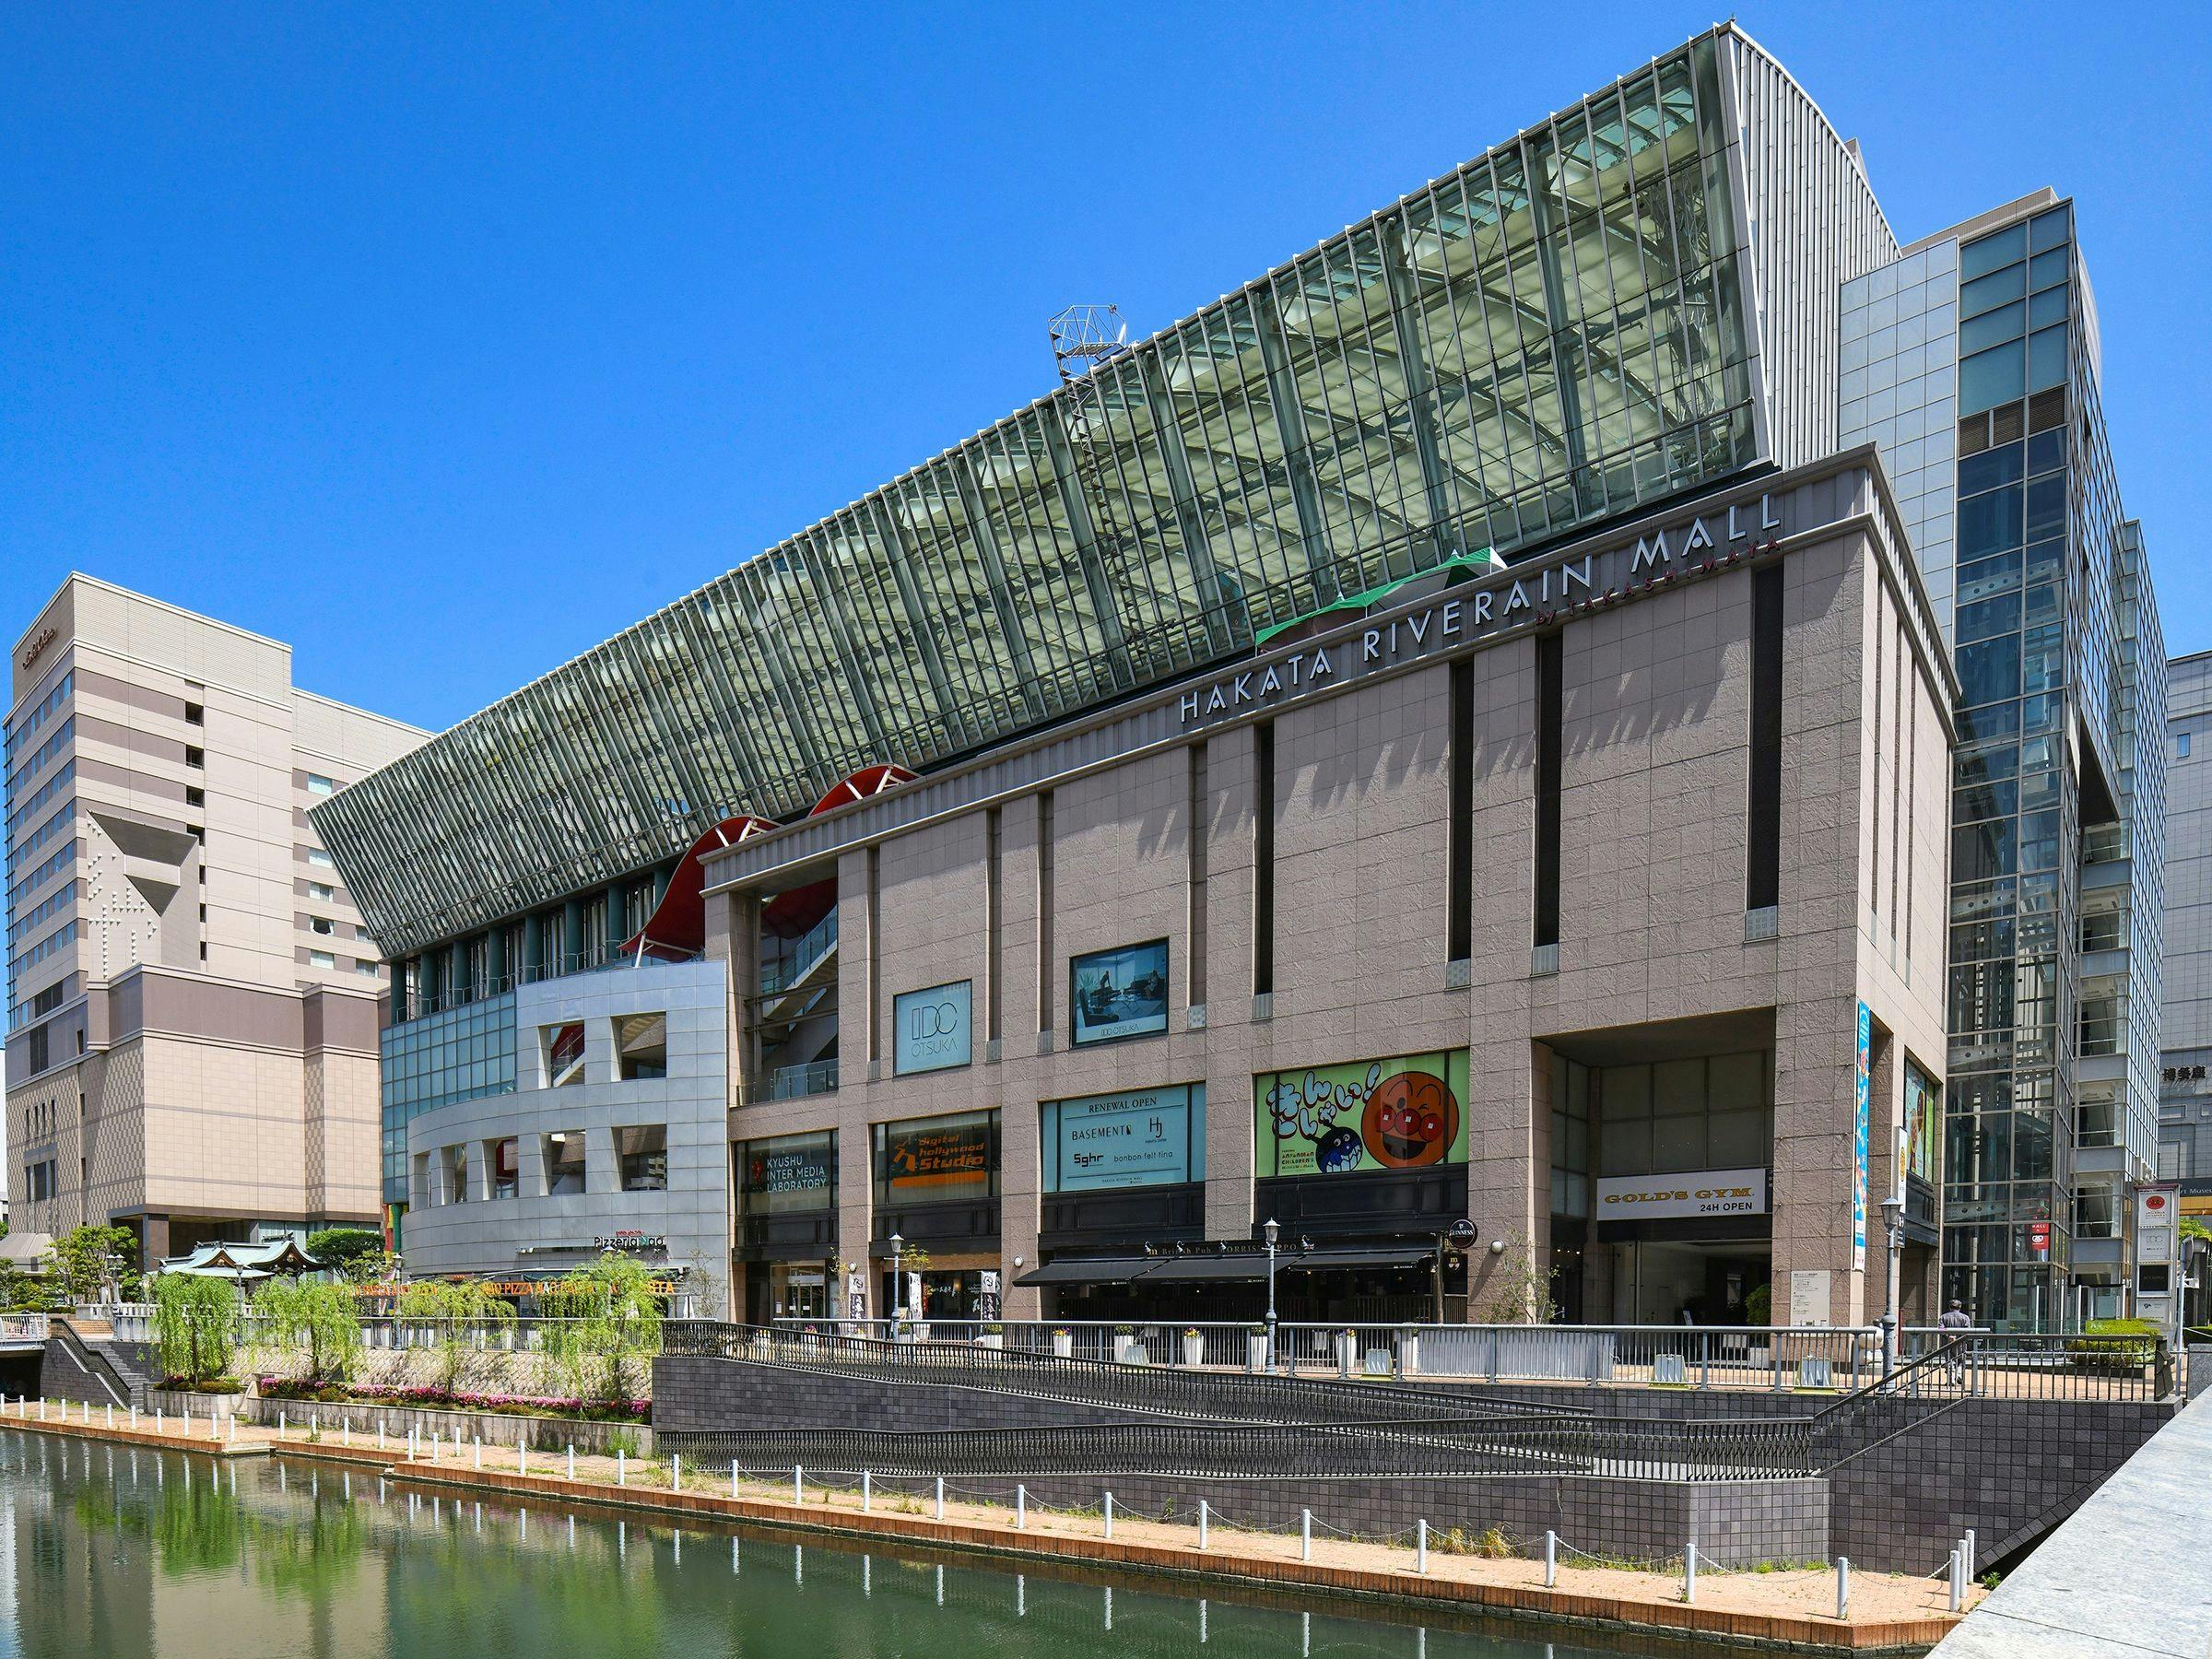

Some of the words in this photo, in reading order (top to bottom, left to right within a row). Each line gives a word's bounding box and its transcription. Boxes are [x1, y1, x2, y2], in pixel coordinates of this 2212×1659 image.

[1535, 608, 1557, 626] by
[1568, 535, 1782, 616] TAKASHIMAYA
[1181, 647, 1334, 723] HAKATA
[1363, 555, 1592, 662] RIVERAIN
[1630, 493, 1781, 574] MALL
[912, 1002, 958, 1041] IDC
[911, 1038, 958, 1057] OTSUKA
[1088, 1100, 1130, 1113] RENEWAL
[1132, 1097, 1158, 1107] OPEN
[1072, 1124, 1125, 1141] BASEMENT
[918, 1135, 960, 1147] digital
[919, 1142, 985, 1157] hollywood
[1113, 1152, 1142, 1162] bonbon
[767, 1156, 803, 1168] KYUSHU
[1074, 1152, 1104, 1168] Sghr
[767, 1169, 794, 1181] INTER
[796, 1165, 825, 1178] MEDIA
[767, 1177, 827, 1193] LABORATORY
[1605, 1190, 1688, 1204] GOLD'S
[1700, 1203, 1720, 1212] 24H
[1723, 1202, 1753, 1211] OPEN
[594, 1236, 639, 1248] Pizzeria
[1195, 1246, 1211, 1254] Pub
[1219, 1244, 1261, 1254] ORRIS'
